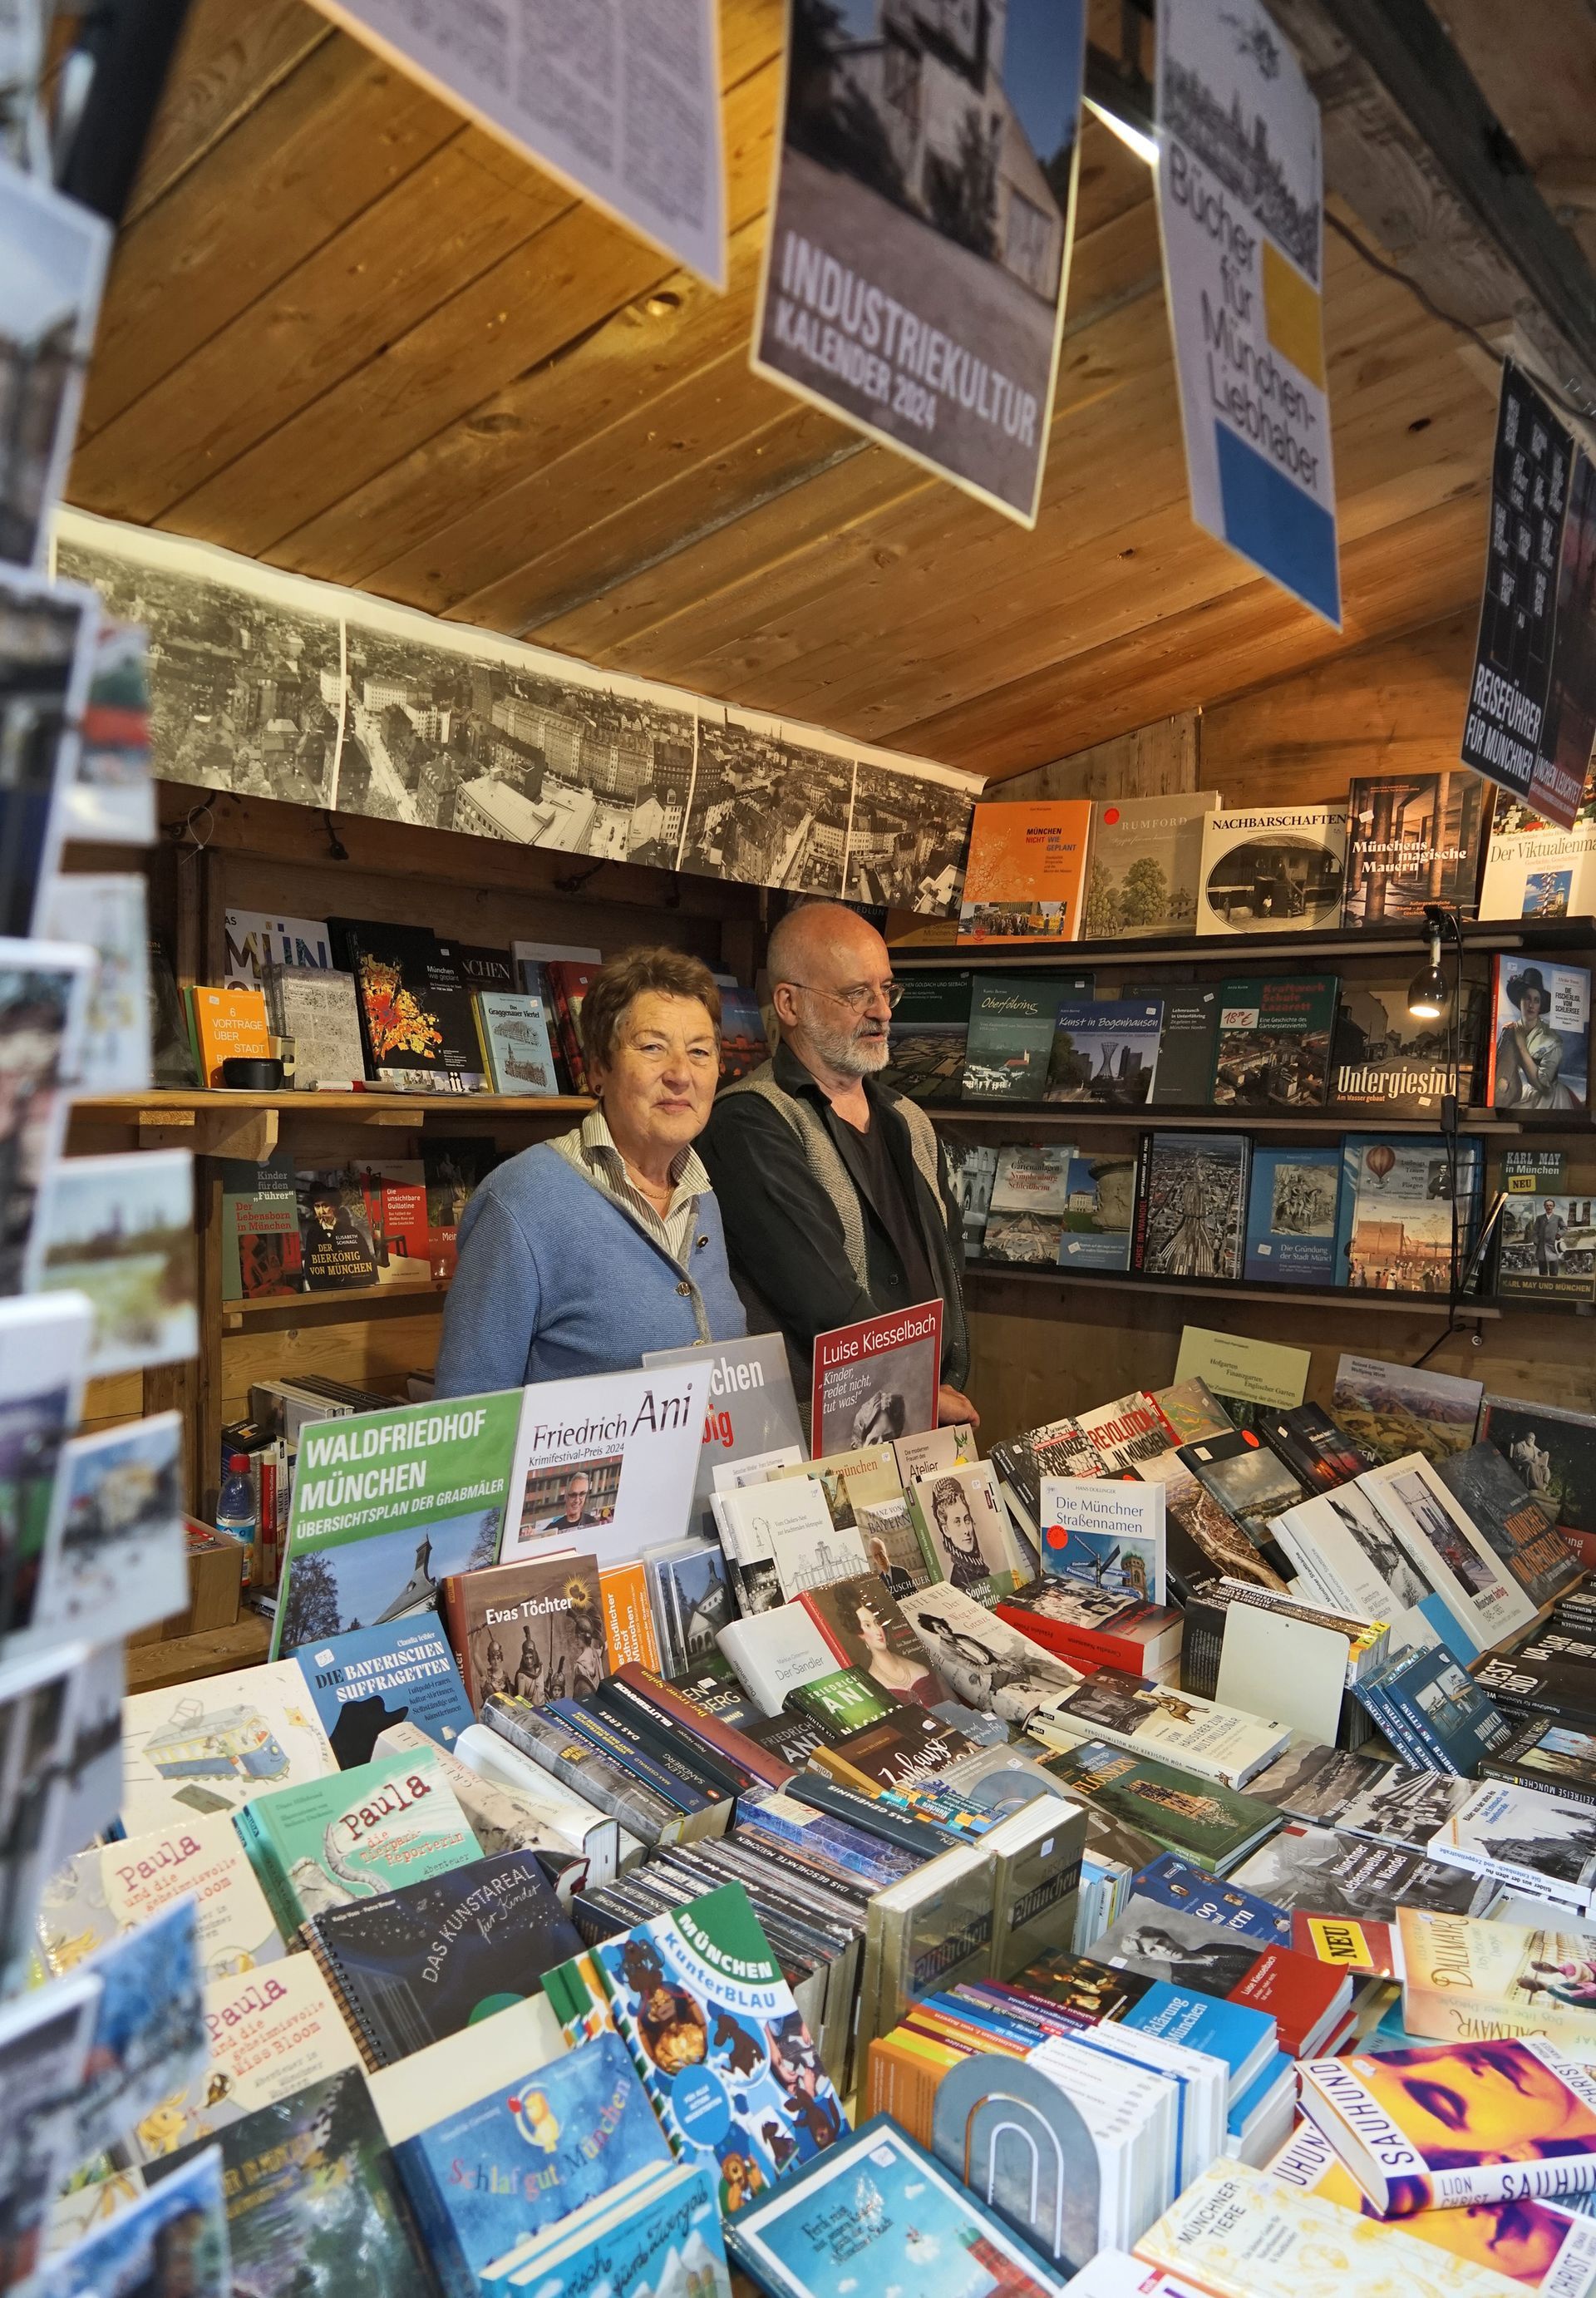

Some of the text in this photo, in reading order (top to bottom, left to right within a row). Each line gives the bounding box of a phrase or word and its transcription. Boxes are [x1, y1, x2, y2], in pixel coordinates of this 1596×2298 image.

[1168, 143, 1256, 274] Bücher
[1220, 254, 1253, 323] für
[781, 229, 1038, 450] INDUSTRIEKULTUR
[774, 298, 938, 434] KALENDER 2024
[1200, 288, 1317, 431] München-
[1206, 349, 1319, 491] Liebhaber
[1473, 663, 1543, 745] REISEFÜHRER
[1465, 709, 1534, 784] FÜR MÜNCHNER
[1027, 826, 1062, 836] MÜNCHEN
[1122, 816, 1189, 831] RUMFORD
[1211, 813, 1347, 831] NACHBARSCHAFTEN
[1026, 836, 1062, 844] NICHT WIE
[1046, 844, 1077, 853] GEPLANT
[1352, 839, 1429, 855] Münchens
[1397, 847, 1468, 865] magische
[1490, 845, 1514, 863] Der
[1361, 860, 1420, 875] Mauern
[426, 964, 455, 974] München
[212, 1017, 264, 1030] VORTRÄGE
[229, 1007, 236, 1016] 6
[1058, 1017, 1086, 1028] Kunst
[1098, 1017, 1159, 1031] Bogenhausen
[214, 1029, 239, 1041] ÜBER
[234, 1043, 265, 1053] STADT
[1366, 1096, 1386, 1104] gebaut
[1505, 1164, 1560, 1175] in München
[1506, 1151, 1562, 1166] KARL MAY
[257, 1171, 288, 1181] Kinder
[257, 1181, 288, 1191] für den
[1512, 1179, 1532, 1190] NEU
[234, 1201, 253, 1211] Der
[387, 1195, 421, 1203] unsichtbare
[387, 1201, 416, 1211] Guillotine
[236, 1211, 291, 1221] Lebensborn
[237, 1220, 292, 1231] in München
[1137, 1200, 1148, 1230] WANDEL
[318, 1243, 333, 1253] DER
[334, 1233, 358, 1242] ELISABETH
[1295, 1245, 1328, 1255] Gründung
[309, 1261, 373, 1276] VON MÜNCHEN
[311, 1250, 362, 1265] BIERKÖNIG
[1135, 1244, 1144, 1269] ACHSE
[1522, 1281, 1537, 1290] MAY
[1539, 1283, 1553, 1291] UND
[1554, 1281, 1591, 1293] MÜNCHEN
[823, 1313, 936, 1365] Luise Kiesselbach
[823, 1373, 872, 1400] redet nicht,
[1275, 1388, 1296, 1398] Garten
[532, 1382, 692, 1452] Friedrich Ani
[822, 1401, 836, 1415] tut
[306, 1408, 487, 1469] WALDFRIEDHOF
[1086, 1406, 1156, 1452] REVOLUTION
[528, 1442, 625, 1467] Krimifestival-Preis 2024
[1039, 1439, 1087, 1465] SCHWARZE
[1111, 1448, 1127, 1467] IN
[1122, 1429, 1169, 1464] MÜNCHEN
[909, 1460, 939, 1480] Atelier
[299, 1460, 426, 1513] MÜNCHEN
[1091, 1486, 1117, 1495] DOLLINGER
[296, 1477, 505, 1539] ÜBERSICHTSPLAN DER GRABMÄLER
[1056, 1496, 1144, 1517] Die Münchner
[1056, 1511, 1143, 1534] Straßennamen
[889, 1575, 931, 1595] ZUSCHAUER
[965, 1582, 992, 1599] Sophie
[485, 1606, 520, 1626] Evas
[520, 1595, 574, 1618] Töchter
[606, 1593, 623, 1652] Südlicher
[314, 1640, 446, 1691] DIE BAYERISCHEN
[774, 1654, 825, 1682] Der Sandler
[1473, 1658, 1518, 1687] WEST
[335, 1657, 451, 1703] SUFFRAGETTEN
[806, 1674, 860, 1701] FRIEDRICH
[1499, 1674, 1539, 1694] END
[825, 1680, 876, 1716] ANI
[598, 1709, 640, 1741] DAS ERBE
[760, 1720, 815, 1748] FRIEDRICH
[1163, 1731, 1185, 1744] VOM
[779, 1732, 828, 1764] ANI
[662, 1753, 706, 1785] SANDBERG
[827, 1783, 914, 1825] GEHEIMNIS DAS
[1518, 1776, 1596, 1807] MÜNCHEN ZEITREISE
[338, 1771, 432, 1841] Paula
[367, 1829, 389, 1847] die
[385, 1832, 466, 1867] Reporterin
[115, 1835, 202, 1893] Paula
[422, 1852, 470, 1876] Abenteuer
[1329, 1841, 1369, 1877] Münchner
[1338, 1847, 1390, 1895] Lebenswelten
[1379, 1853, 1409, 1886] Wandel
[422, 1864, 536, 1984] DAS KUNSTAREAL
[677, 1912, 774, 1980] MÜNCHEN
[1323, 1925, 1357, 1959] NEU
[1431, 1918, 1474, 1989] DALLMAYR
[663, 1931, 777, 2010] KunterBLAU
[204, 1977, 288, 2043] Paula
[1309, 2061, 1416, 2166] SAUHUND
[1440, 2175, 1475, 2197] LION
[1176, 2177, 1244, 2246] MÜNCHNER
[1206, 2203, 1248, 2241] TIERE
